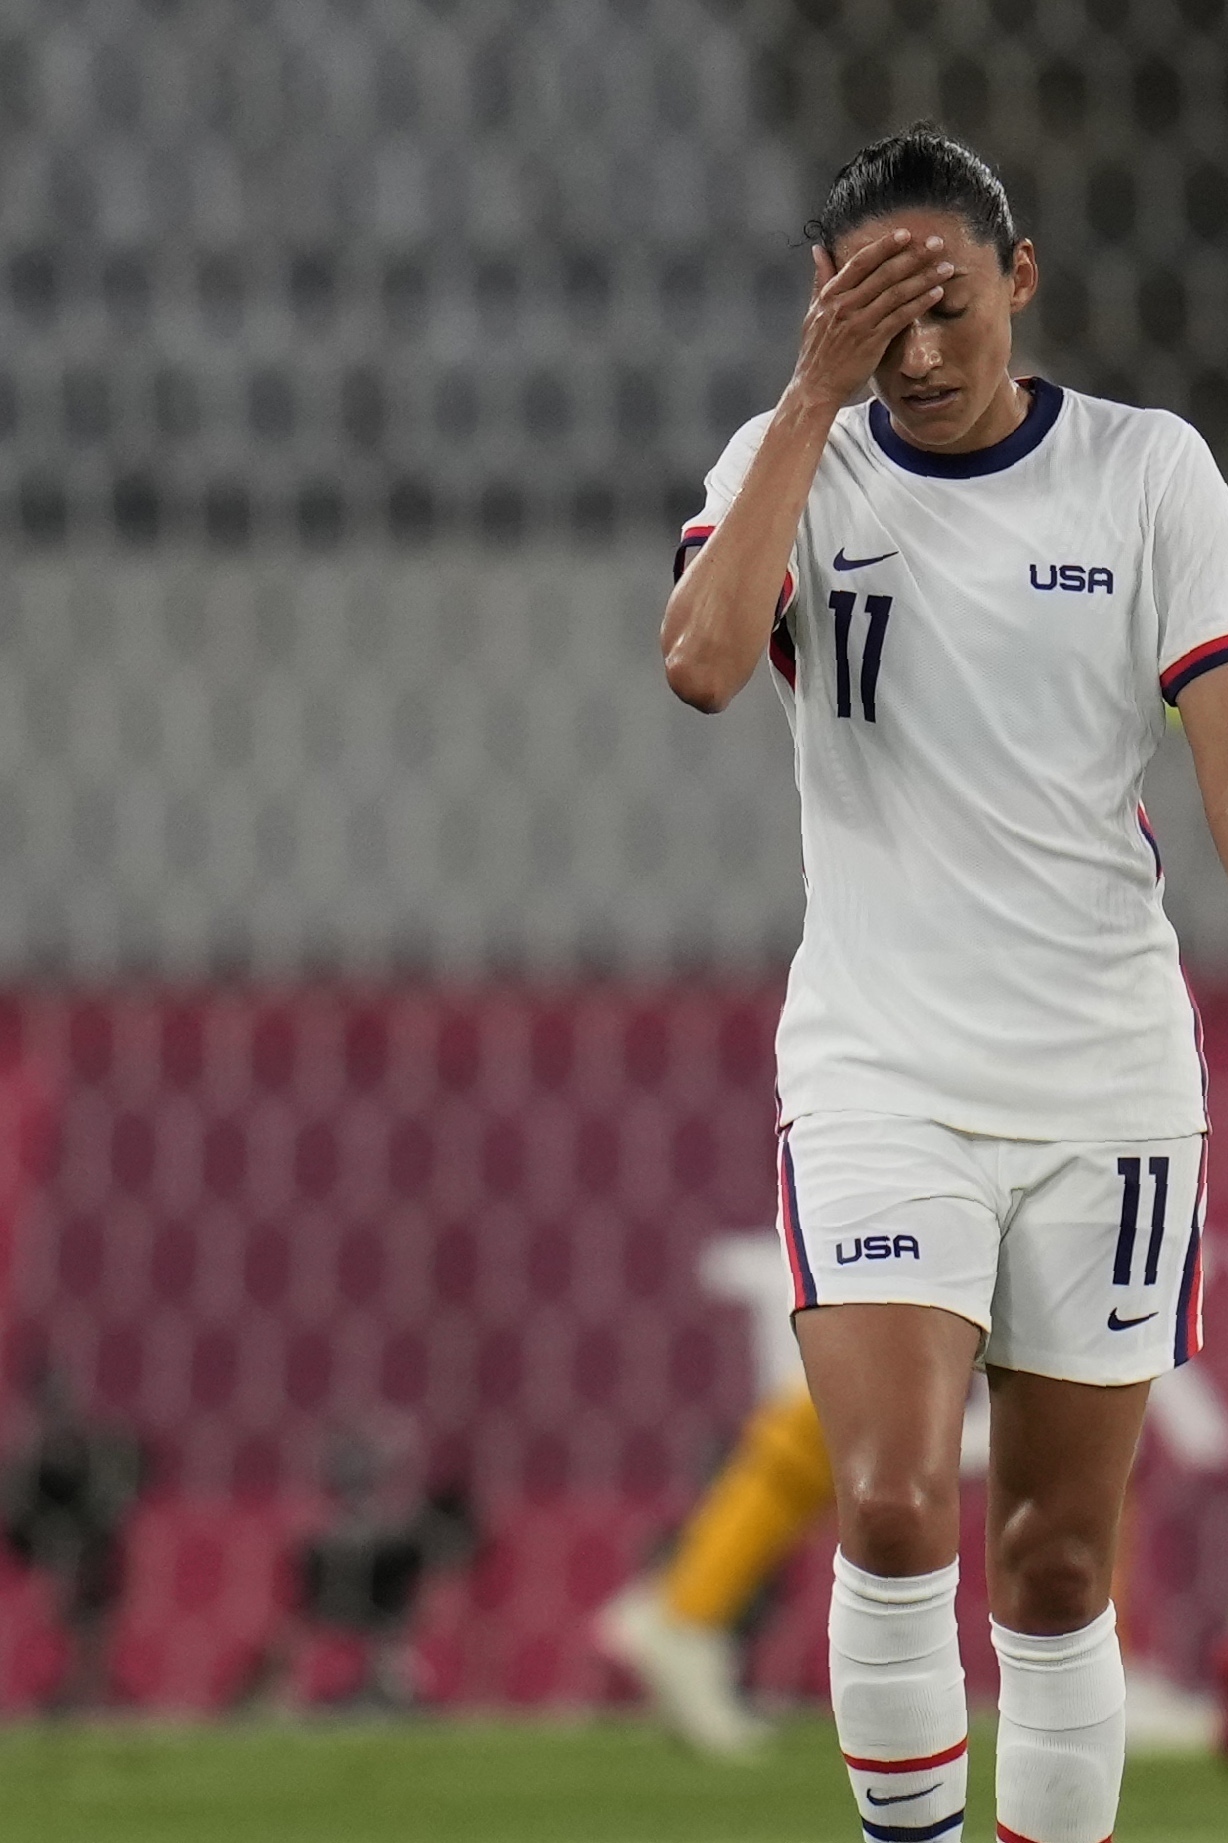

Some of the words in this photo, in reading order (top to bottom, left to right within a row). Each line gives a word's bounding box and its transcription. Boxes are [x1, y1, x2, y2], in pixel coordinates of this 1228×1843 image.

[1029, 564, 1113, 594] USA
[828, 590, 893, 723] 11
[835, 1234, 920, 1265] USA
[1112, 1156, 1170, 1285] 11
